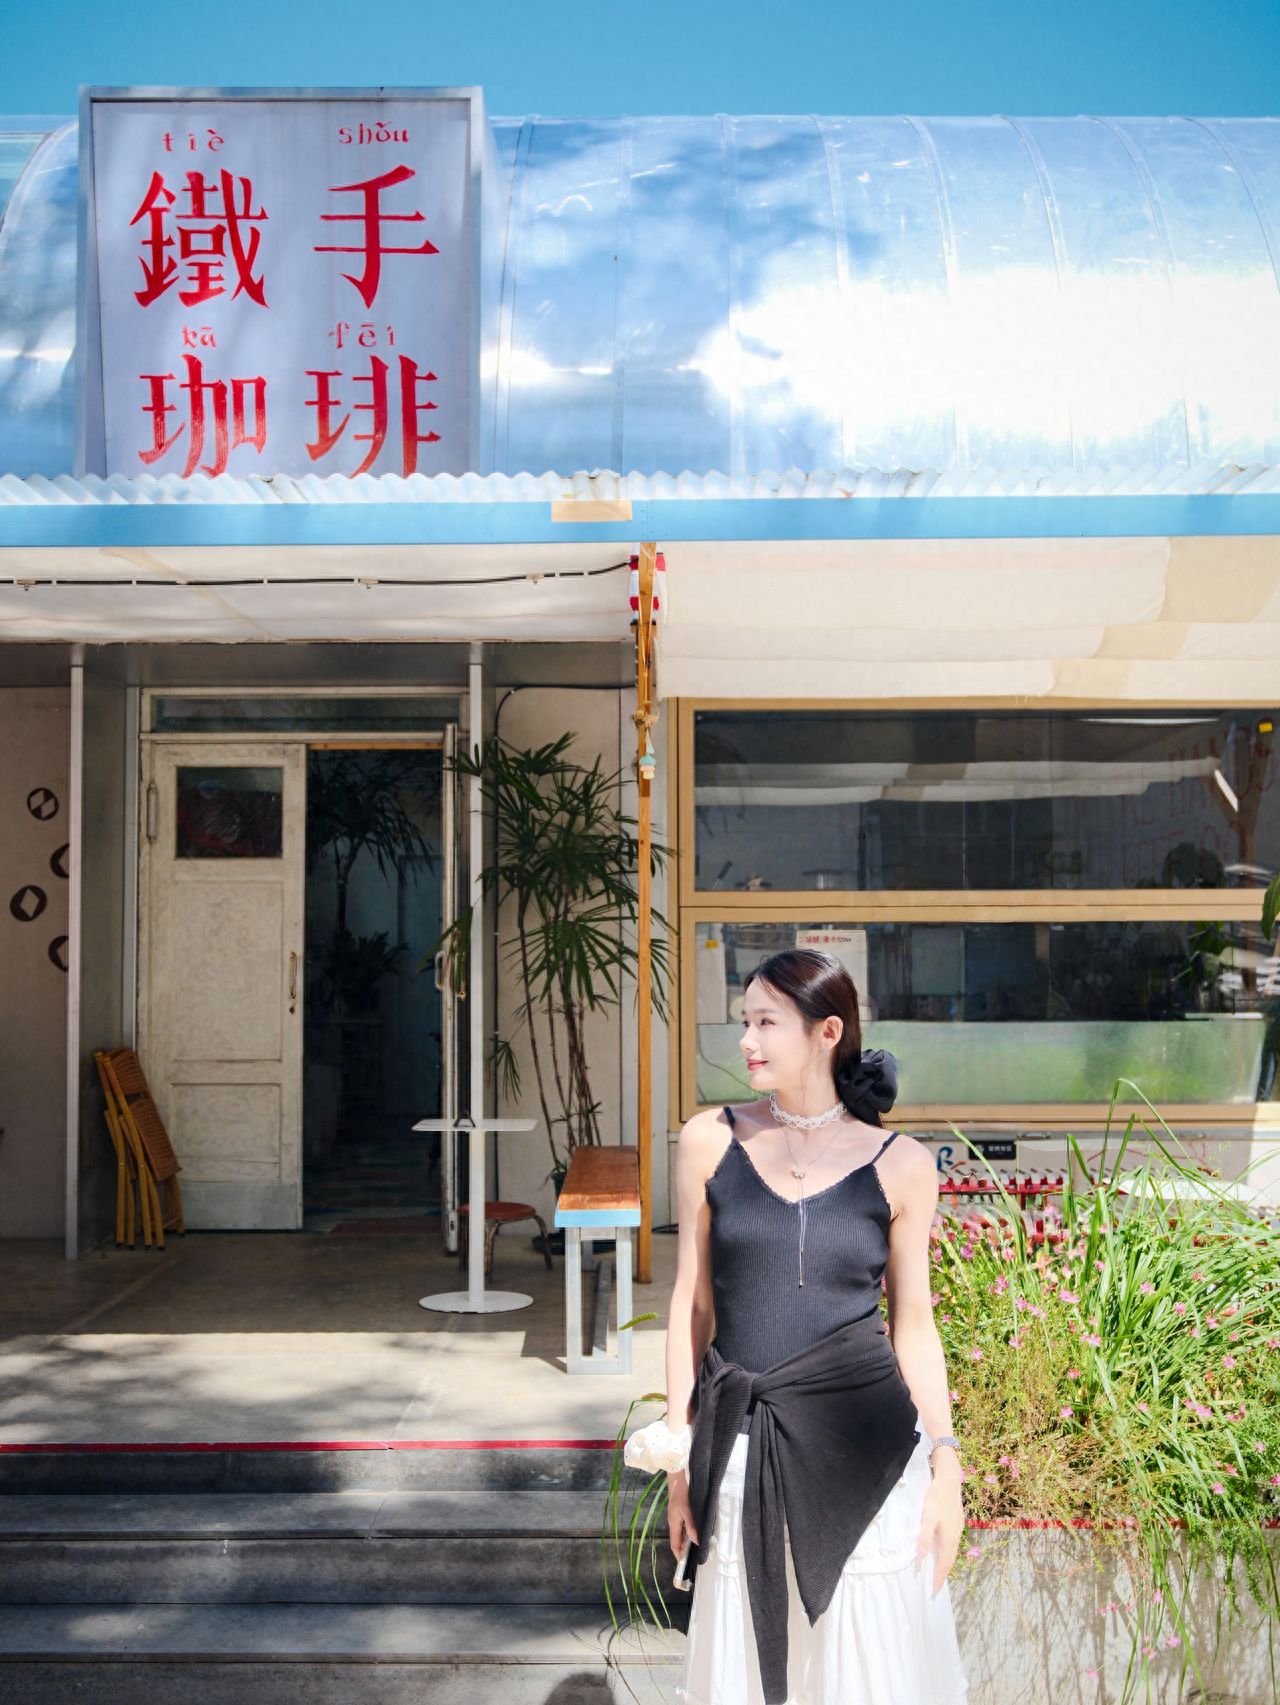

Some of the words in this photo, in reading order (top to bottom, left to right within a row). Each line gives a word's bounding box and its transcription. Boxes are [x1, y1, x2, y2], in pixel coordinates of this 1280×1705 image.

[162, 129, 225, 153] tiè
[129, 164, 441, 309] 鐵手
[182, 325, 217, 349] kā
[327, 322, 396, 349] fēi
